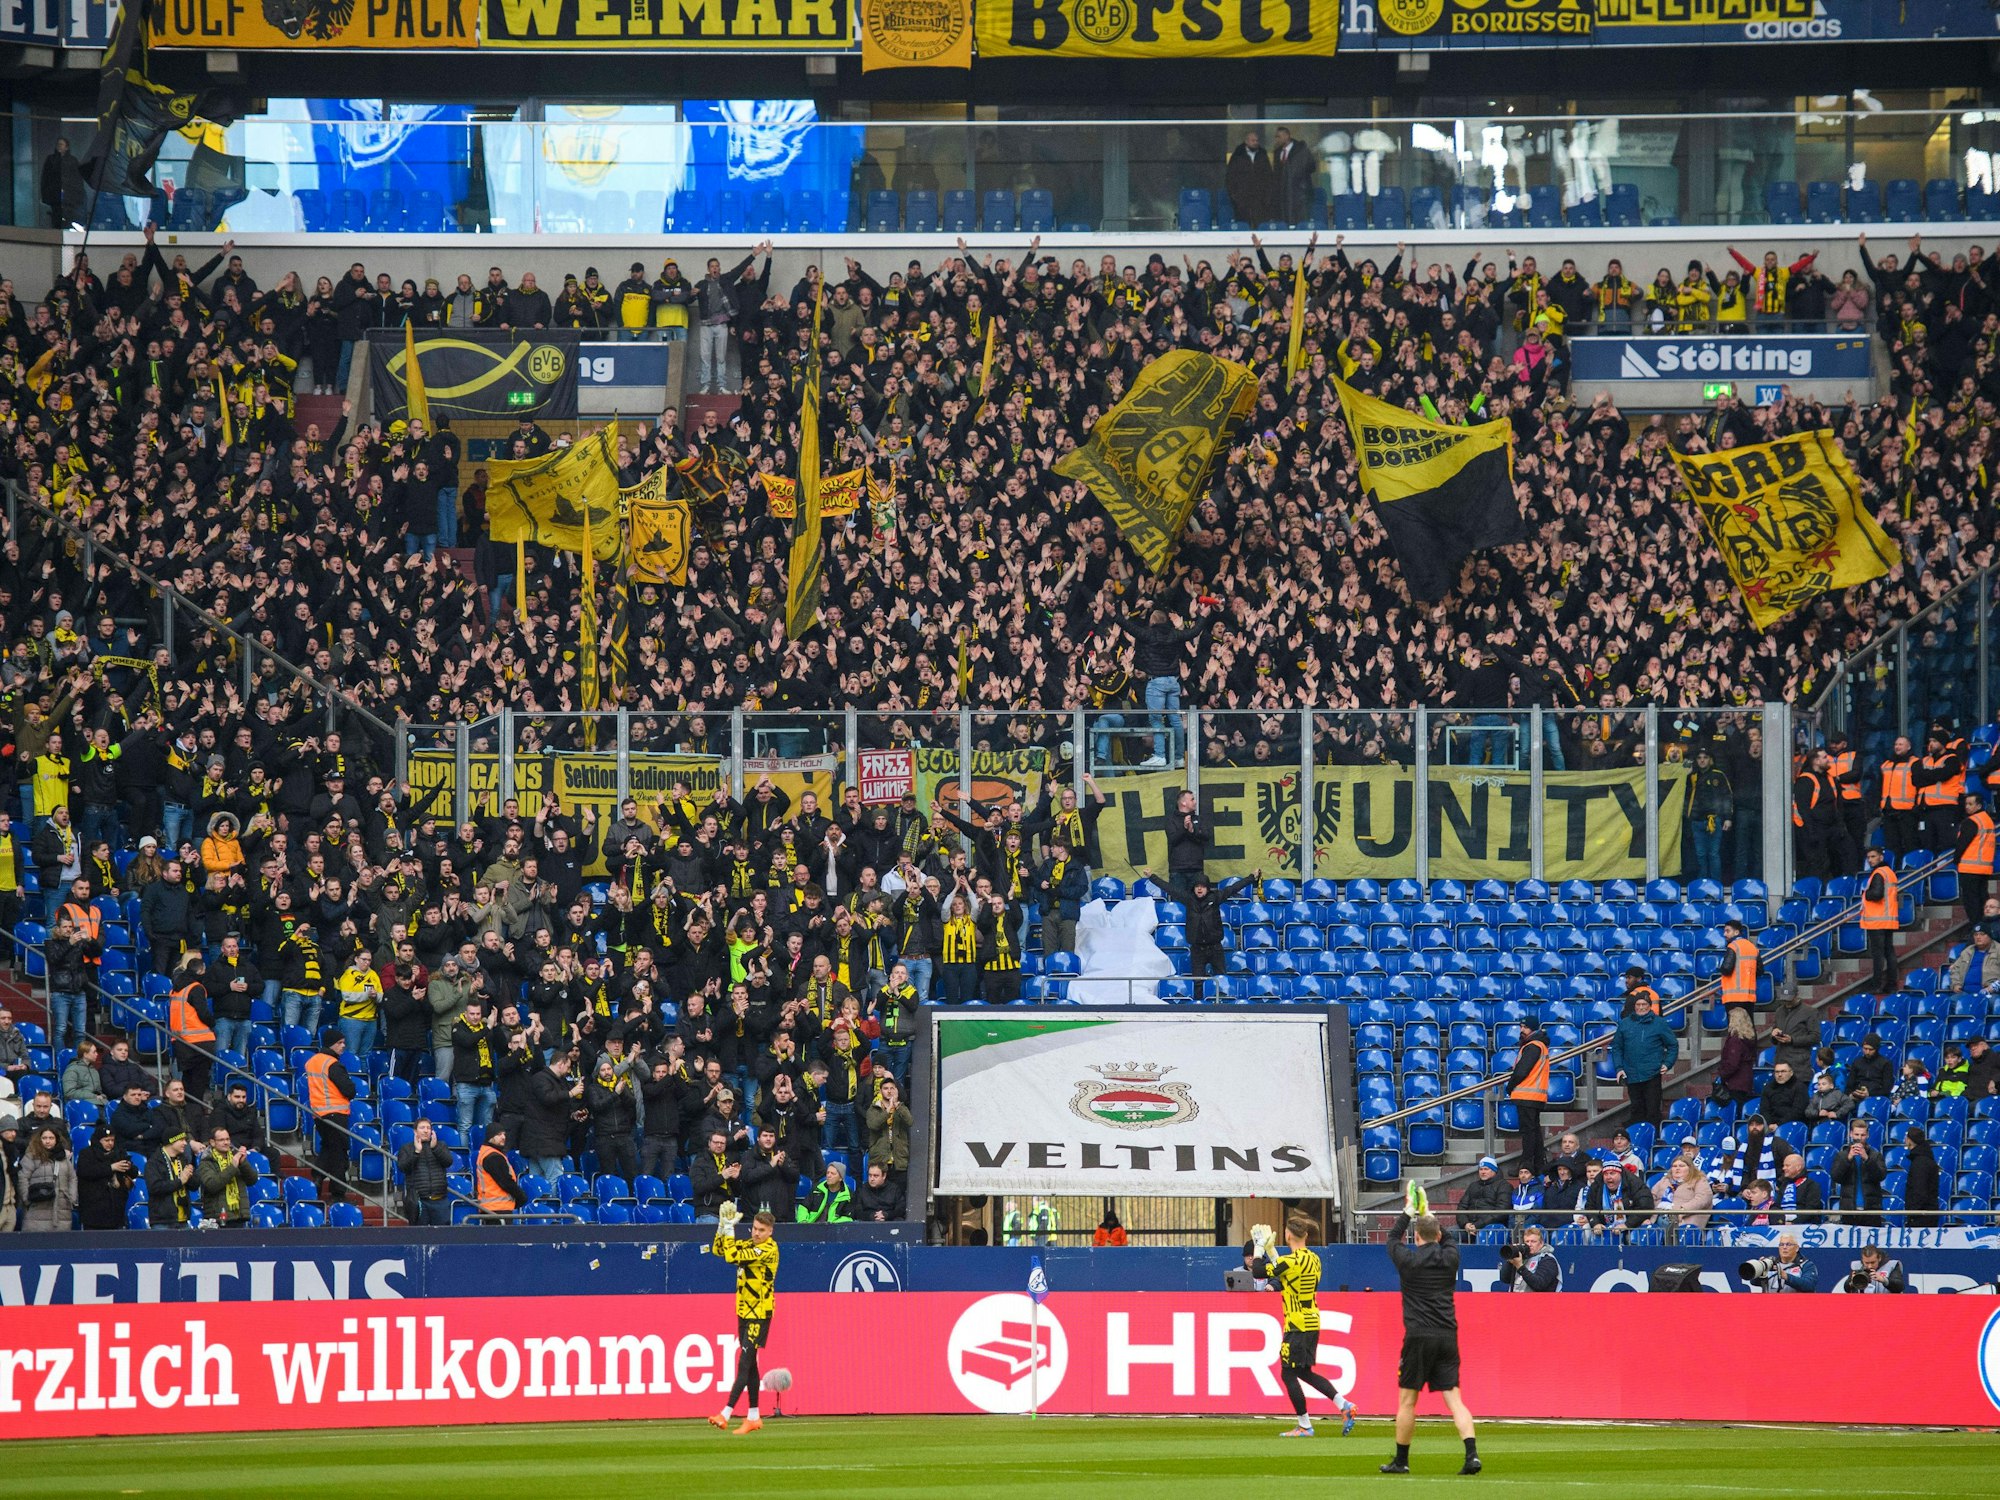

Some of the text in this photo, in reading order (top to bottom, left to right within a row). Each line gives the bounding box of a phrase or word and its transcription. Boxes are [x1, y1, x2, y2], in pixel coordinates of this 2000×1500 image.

[149, 0, 466, 38] WOLF PACK
[500, 0, 837, 35] WEIMAR
[1451, 12, 1591, 34] BORUSSEN
[1744, 18, 1843, 39] adidas
[533, 350, 561, 372] BVB
[1656, 343, 1812, 375] Stölting
[541, 371, 552, 379] 09
[408, 760, 543, 790] HOOGANS
[630, 766, 721, 791] tadionverbot
[862, 754, 909, 778] FREE
[410, 788, 543, 818] DRMUND
[1084, 777, 1680, 870] THE UNITY
[964, 1141, 1313, 1173] VELTINS
[1802, 1223, 1949, 1248] Schalker
[747, 1323, 761, 1337] 33
[1107, 1311, 1357, 1399] HRS
